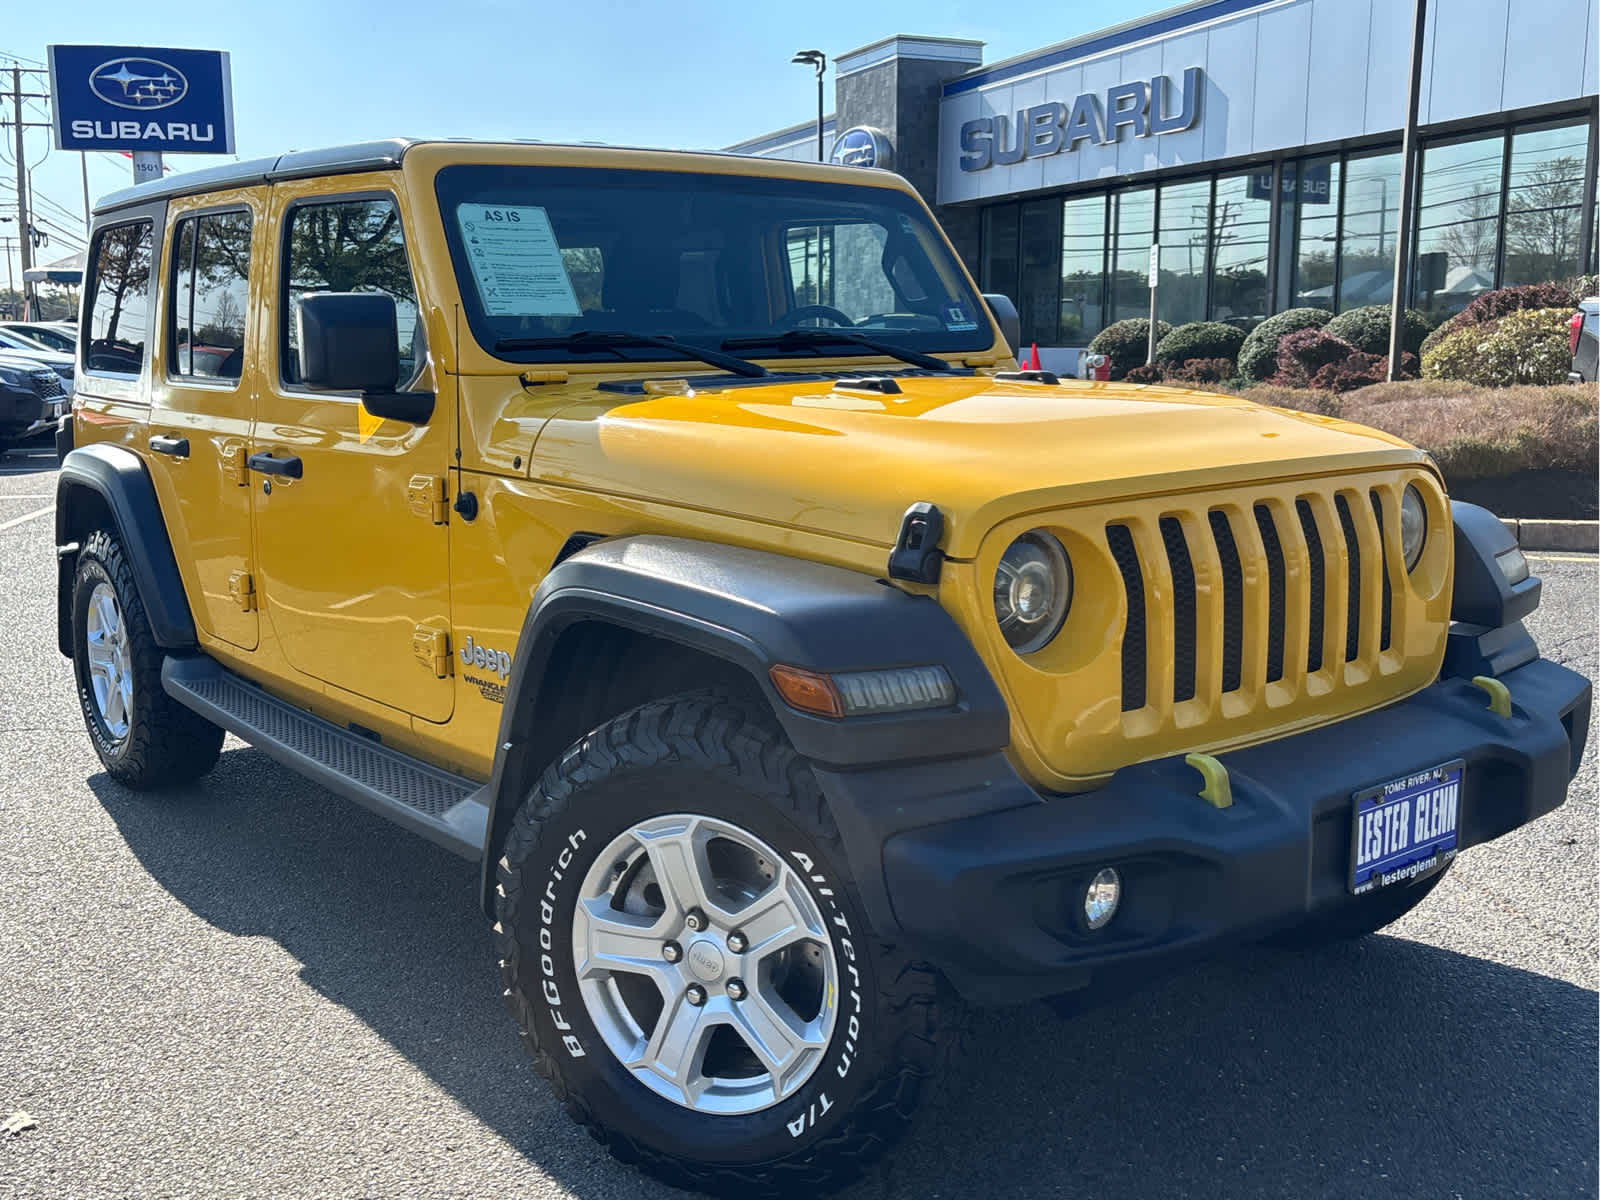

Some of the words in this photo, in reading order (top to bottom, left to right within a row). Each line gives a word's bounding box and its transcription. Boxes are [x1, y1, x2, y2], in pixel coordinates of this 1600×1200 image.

[71, 120, 214, 142] SUBARU
[959, 66, 1203, 172] SUBARU
[136, 163, 159, 172] 1501
[484, 210, 503, 222] AS
[506, 211, 521, 223] IS
[460, 635, 511, 680] Jeep
[463, 673, 507, 692] WRANGLE
[1384, 781, 1406, 796] TOMS
[1408, 772, 1432, 788] RIVER,
[1433, 768, 1443, 779] NJ
[1357, 801, 1410, 866] LESTER
[1414, 783, 1459, 844] GLENN
[540, 828, 588, 1059] BFGoodrich
[791, 850, 861, 1078] All-Terrain
[787, 1092, 834, 1138] T/A
